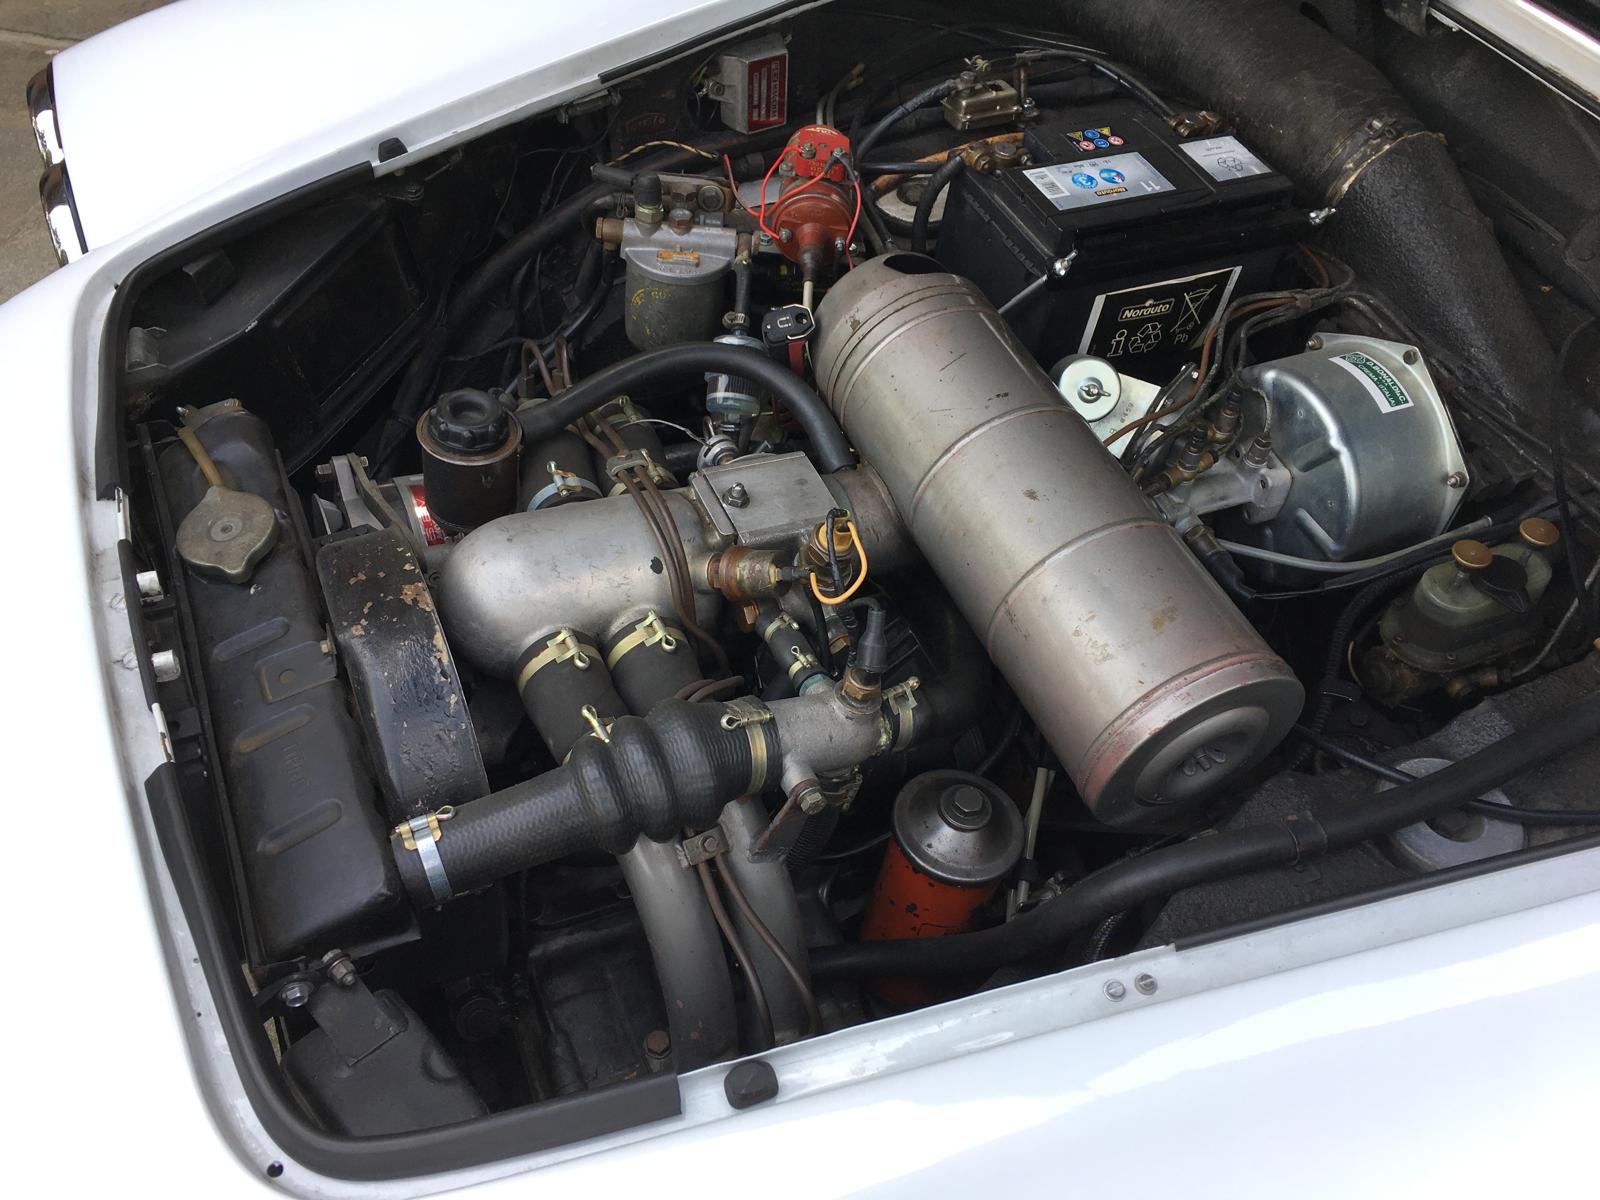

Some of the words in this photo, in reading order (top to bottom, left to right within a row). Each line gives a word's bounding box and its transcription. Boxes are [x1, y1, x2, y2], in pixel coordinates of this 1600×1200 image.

[1140, 180, 1161, 192] 11
[1121, 302, 1170, 319] Norauto
[1174, 333, 1189, 345] Pb
[1358, 364, 1378, 382] CREMA
